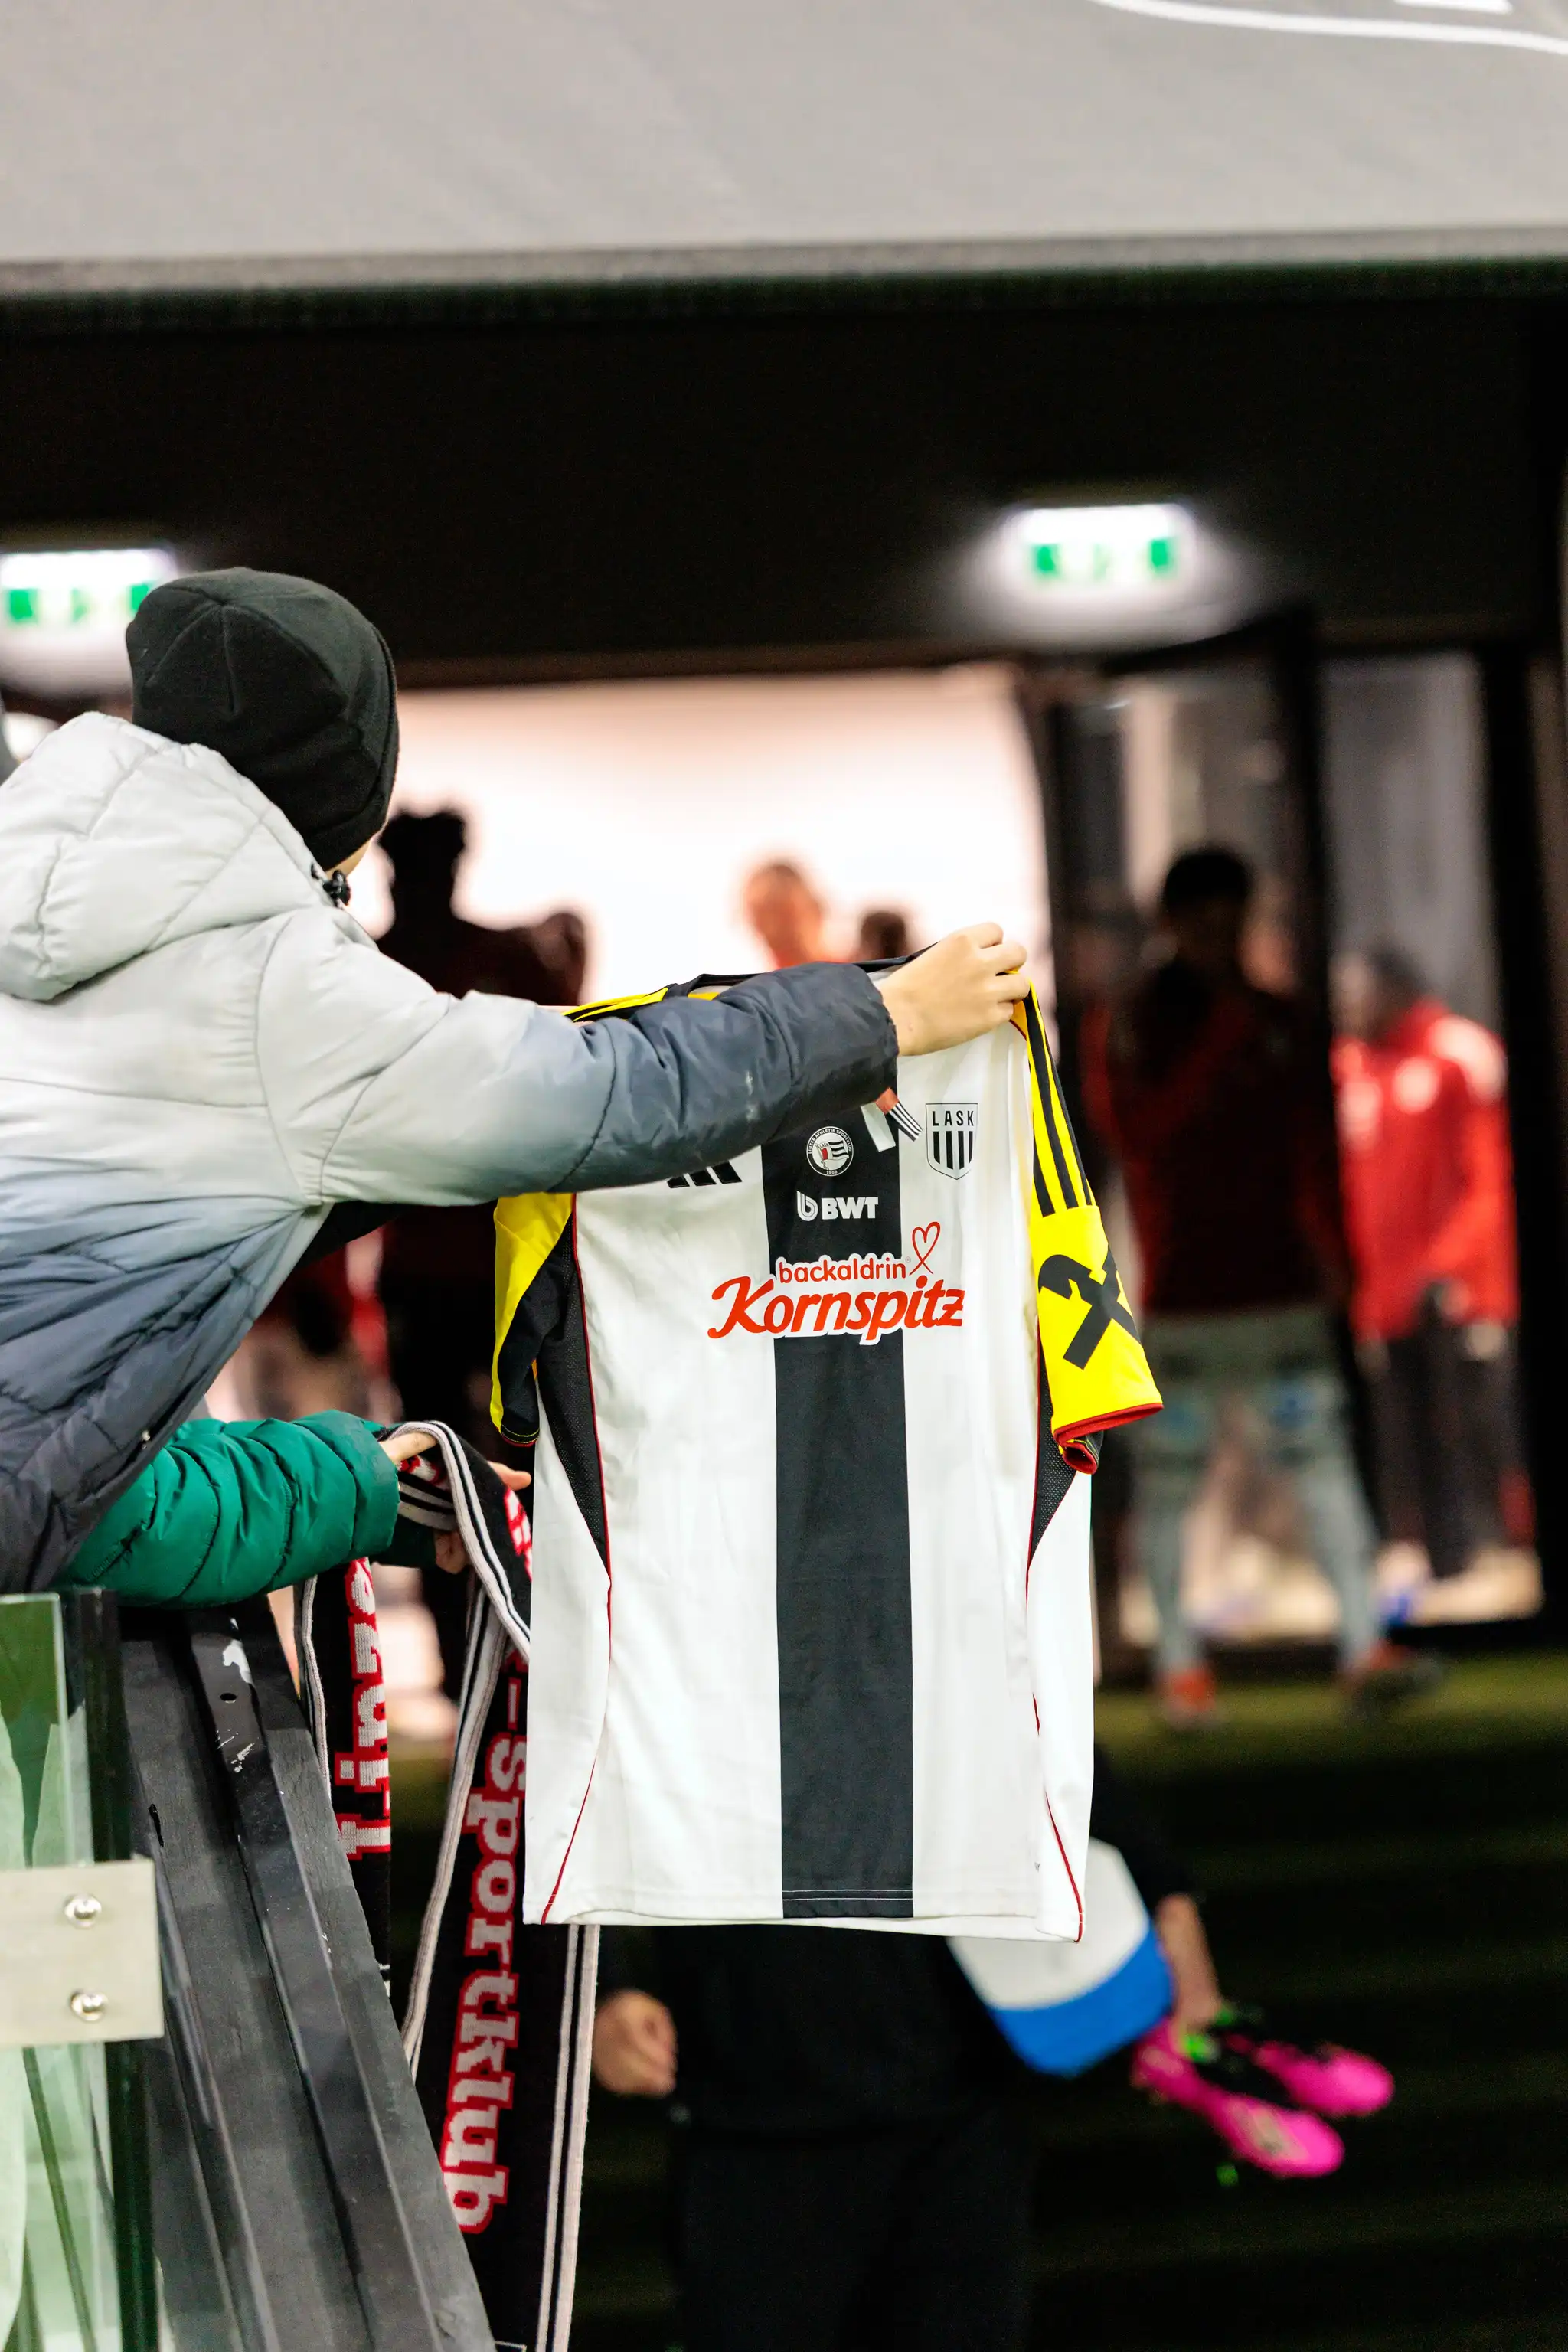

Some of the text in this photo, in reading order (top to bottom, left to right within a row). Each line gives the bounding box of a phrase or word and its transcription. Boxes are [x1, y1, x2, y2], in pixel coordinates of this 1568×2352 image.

[932, 1110, 974, 1126] LASK
[815, 1129, 835, 1138] ATHLETIK
[822, 1197, 879, 1220] BWT
[779, 1257, 906, 1283] backaldrin
[707, 1275, 965, 1341] Kornspitz
